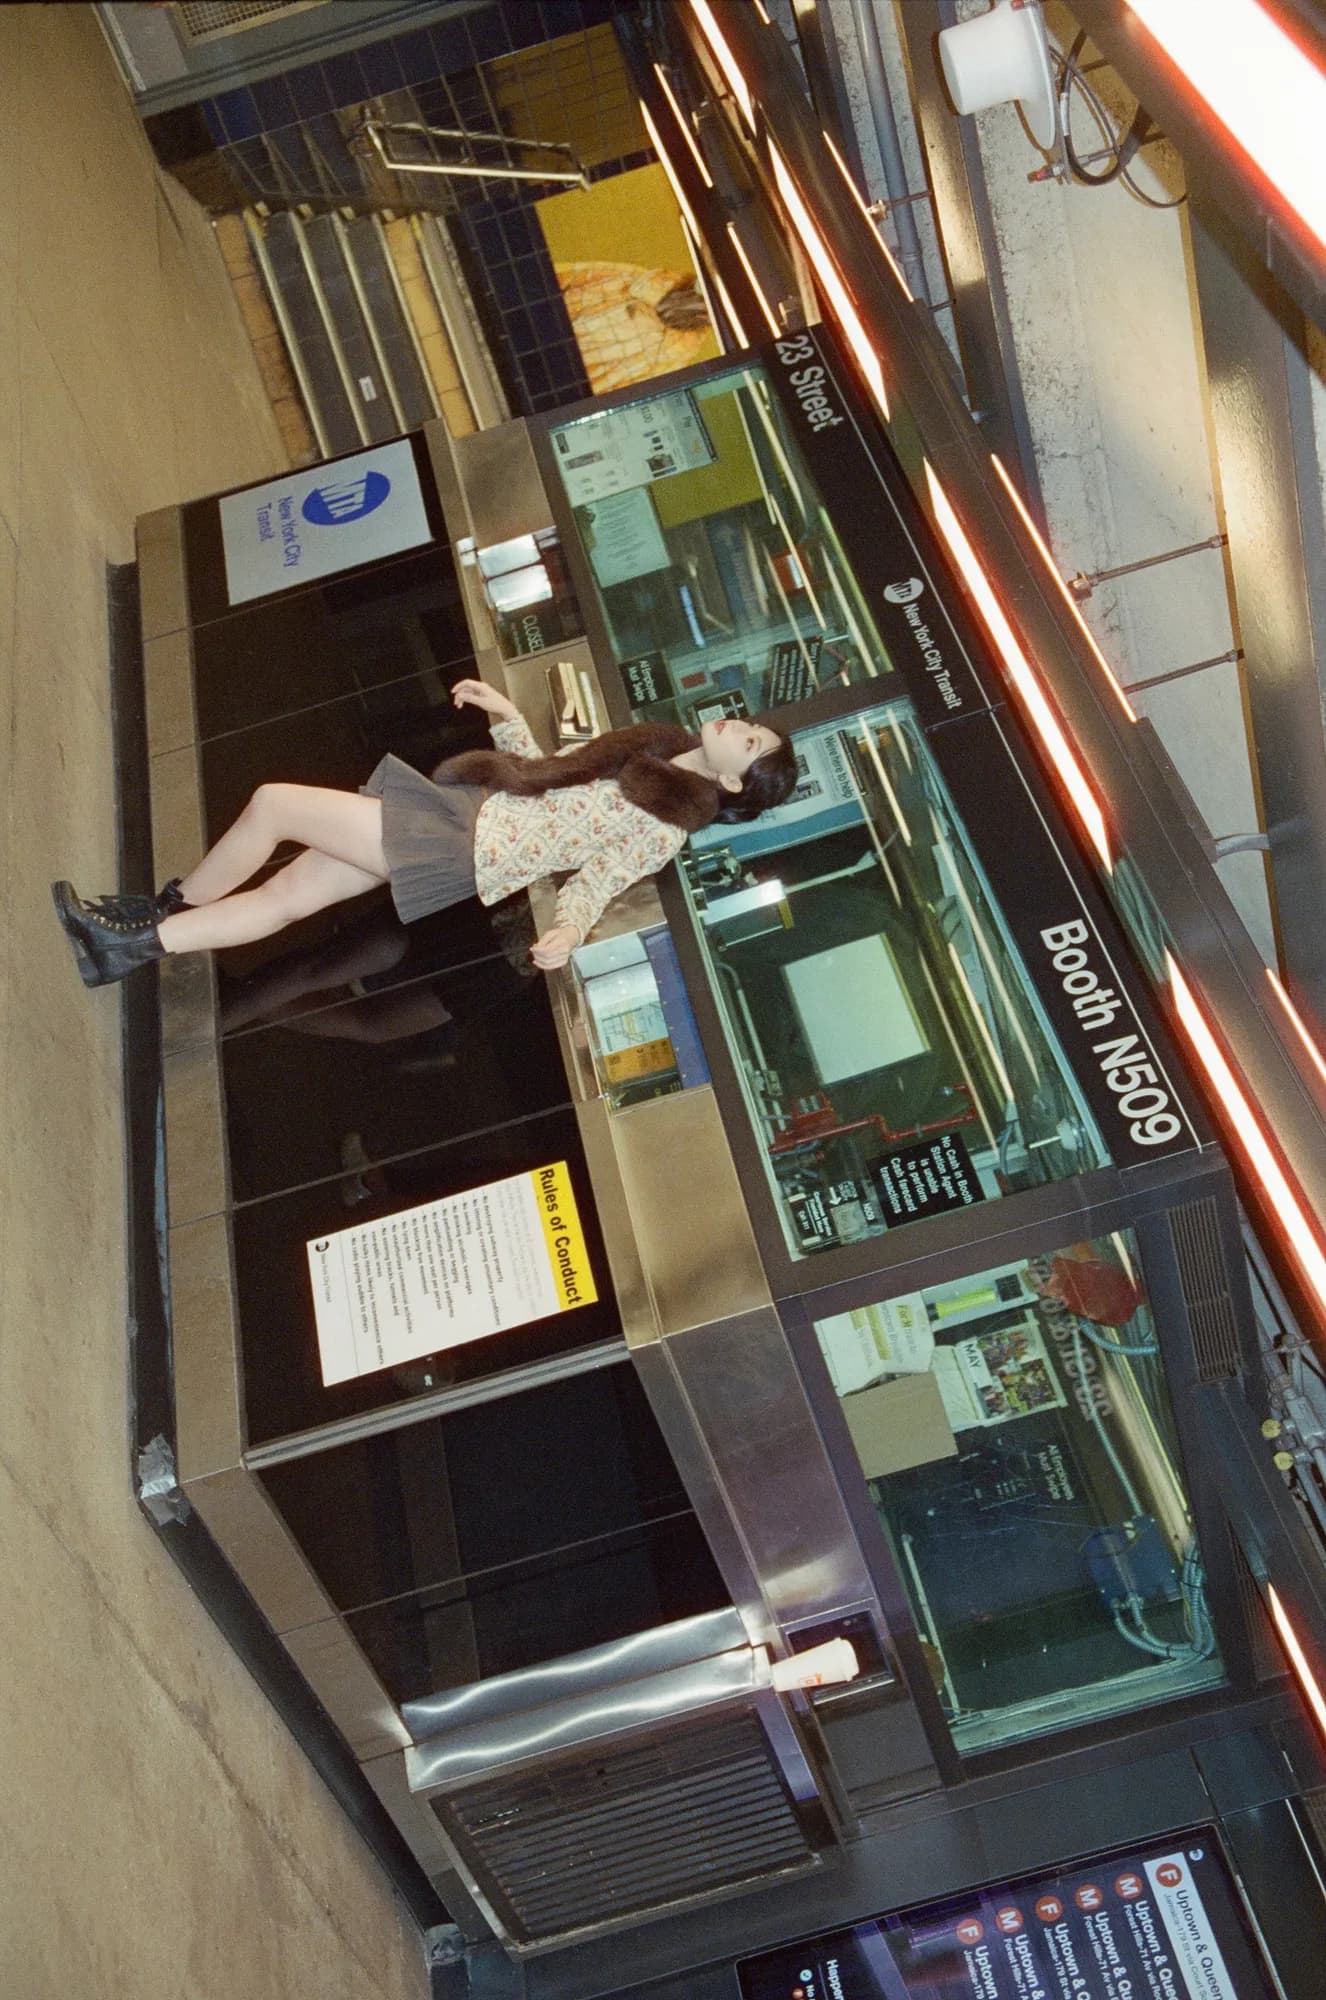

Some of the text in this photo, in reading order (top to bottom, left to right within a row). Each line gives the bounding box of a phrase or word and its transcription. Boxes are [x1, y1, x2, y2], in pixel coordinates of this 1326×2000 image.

[775, 335, 844, 432] 23 Street
[256, 502, 275, 542] Transit
[278, 495, 301, 567] New York City
[903, 603, 962, 709] New York City Transit
[1039, 919, 1181, 1145] Booth N509
[879, 1166, 902, 1214] transactions
[890, 1157, 918, 1212] Cash farecard
[907, 1160, 928, 1203] to perform
[920, 1158, 939, 1194] is unable
[930, 1145, 957, 1199] Station Agent
[941, 1135, 973, 1204] No Cash in Booth
[422, 1215, 427, 1223] No
[432, 1211, 437, 1220] No
[442, 1208, 447, 1216] No
[452, 1205, 457, 1213] No
[462, 1202, 467, 1210] No
[472, 1198, 478, 1207] No
[483, 1195, 488, 1204] No
[351, 1237, 356, 1246] No
[361, 1234, 367, 1242] No
[382, 1227, 387, 1236] No
[391, 1224, 397, 1232] No
[401, 1221, 407, 1229] No
[412, 1218, 417, 1226] No
[539, 1168, 582, 1304] Rules of Conduct
[964, 1343, 981, 1367] MAY
[1079, 1888, 1099, 1907] M
[1095, 1911, 1120, 1965] Uptown
[1112, 1966, 1127, 1978] &
[1119, 1877, 1139, 1896] M
[1135, 1900, 1161, 1953] Uptown
[1153, 1955, 1168, 1967] &
[1160, 1869, 1178, 1885] F
[1176, 1889, 1201, 1941] Uptown
[1195, 1944, 1208, 1954] &
[1163, 1894, 1187, 1942] Jamaica-179
[1000, 1911, 1045, 2000] M Uptown &
[1003, 1937, 1027, 1993] Forest Hills-71
[1040, 1903, 1059, 1914] F
[1055, 1922, 1079, 1976] Uptown
[1072, 1978, 1086, 1990] &
[1043, 1927, 1072, 2000] Jamaica-179 St via
[1083, 1915, 1115, 1997] Forest Hills-71 Av via
[1123, 1904, 1156, 1985] Forest Hills-71 Av via
[1182, 1942, 1191, 1952] St
[1184, 1952, 1195, 1965] via
[806, 1984, 815, 1998] No
[968, 1945, 998, 2000] Uptown
[1191, 1965, 1204, 1989] Court
